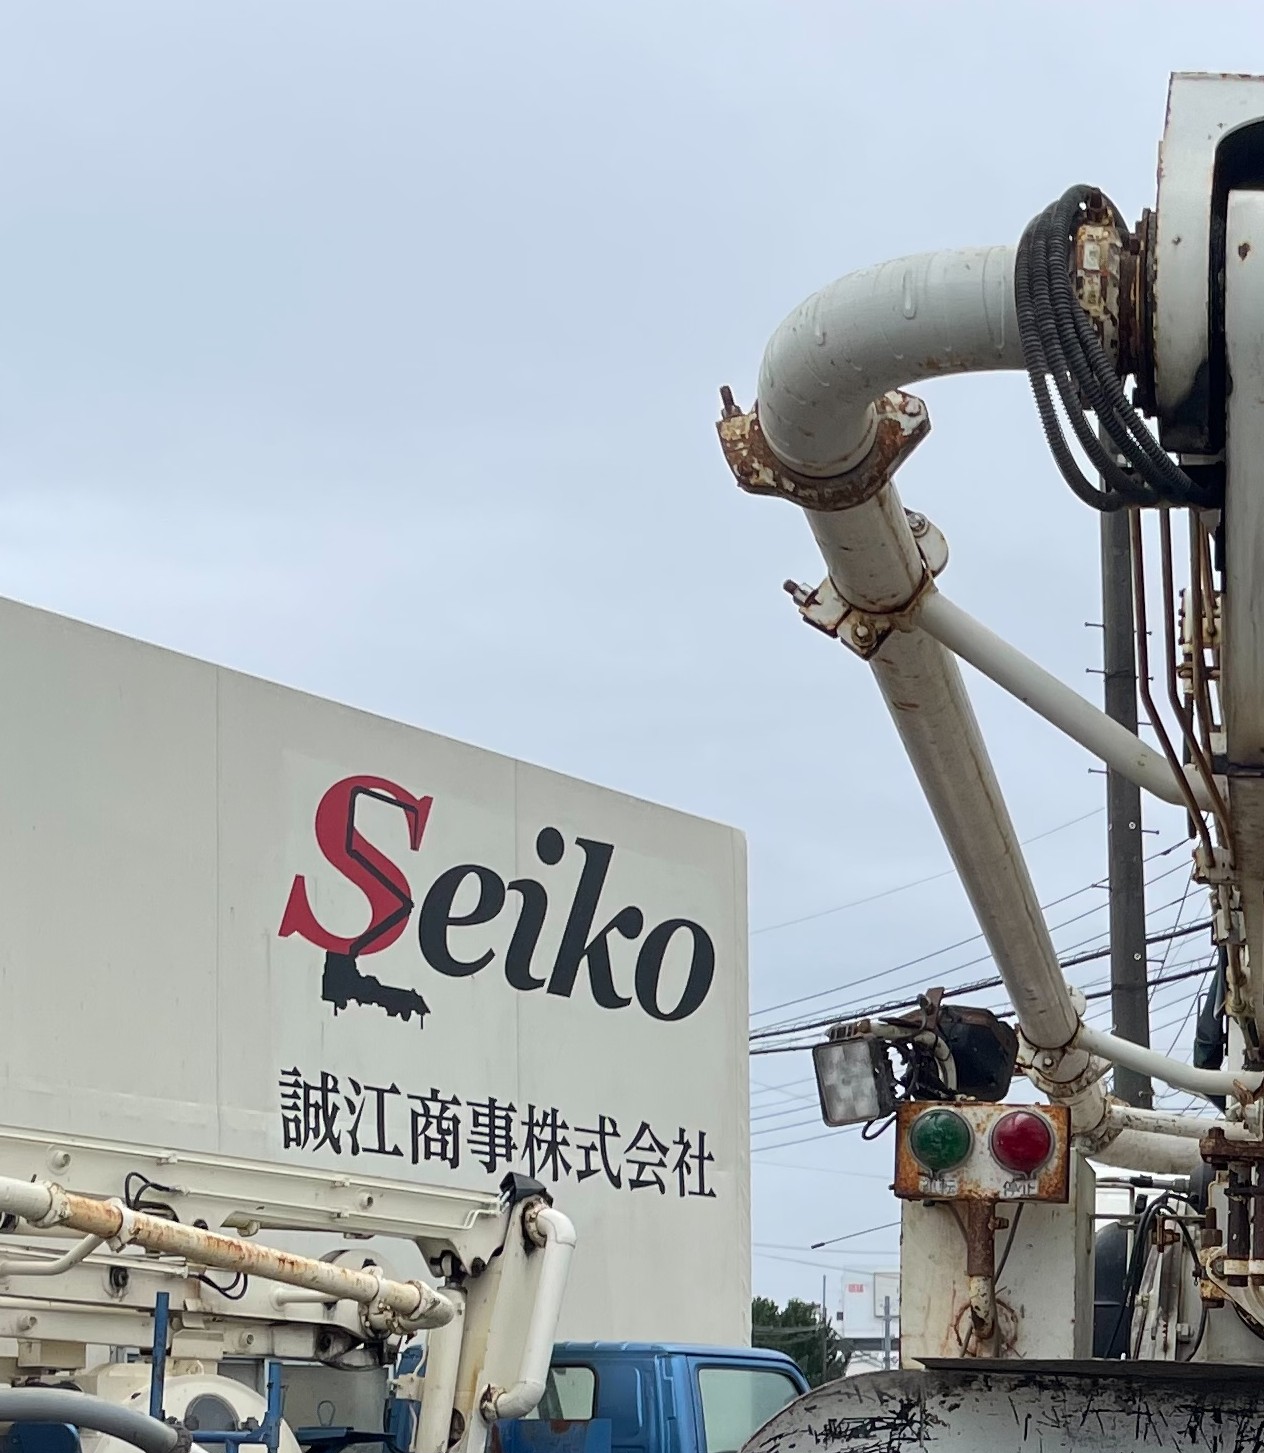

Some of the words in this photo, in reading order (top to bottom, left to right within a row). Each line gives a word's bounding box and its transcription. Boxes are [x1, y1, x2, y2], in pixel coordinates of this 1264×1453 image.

[278, 775, 716, 1022] Seiko
[278, 1066, 717, 1198] 誠江商事株式会社
